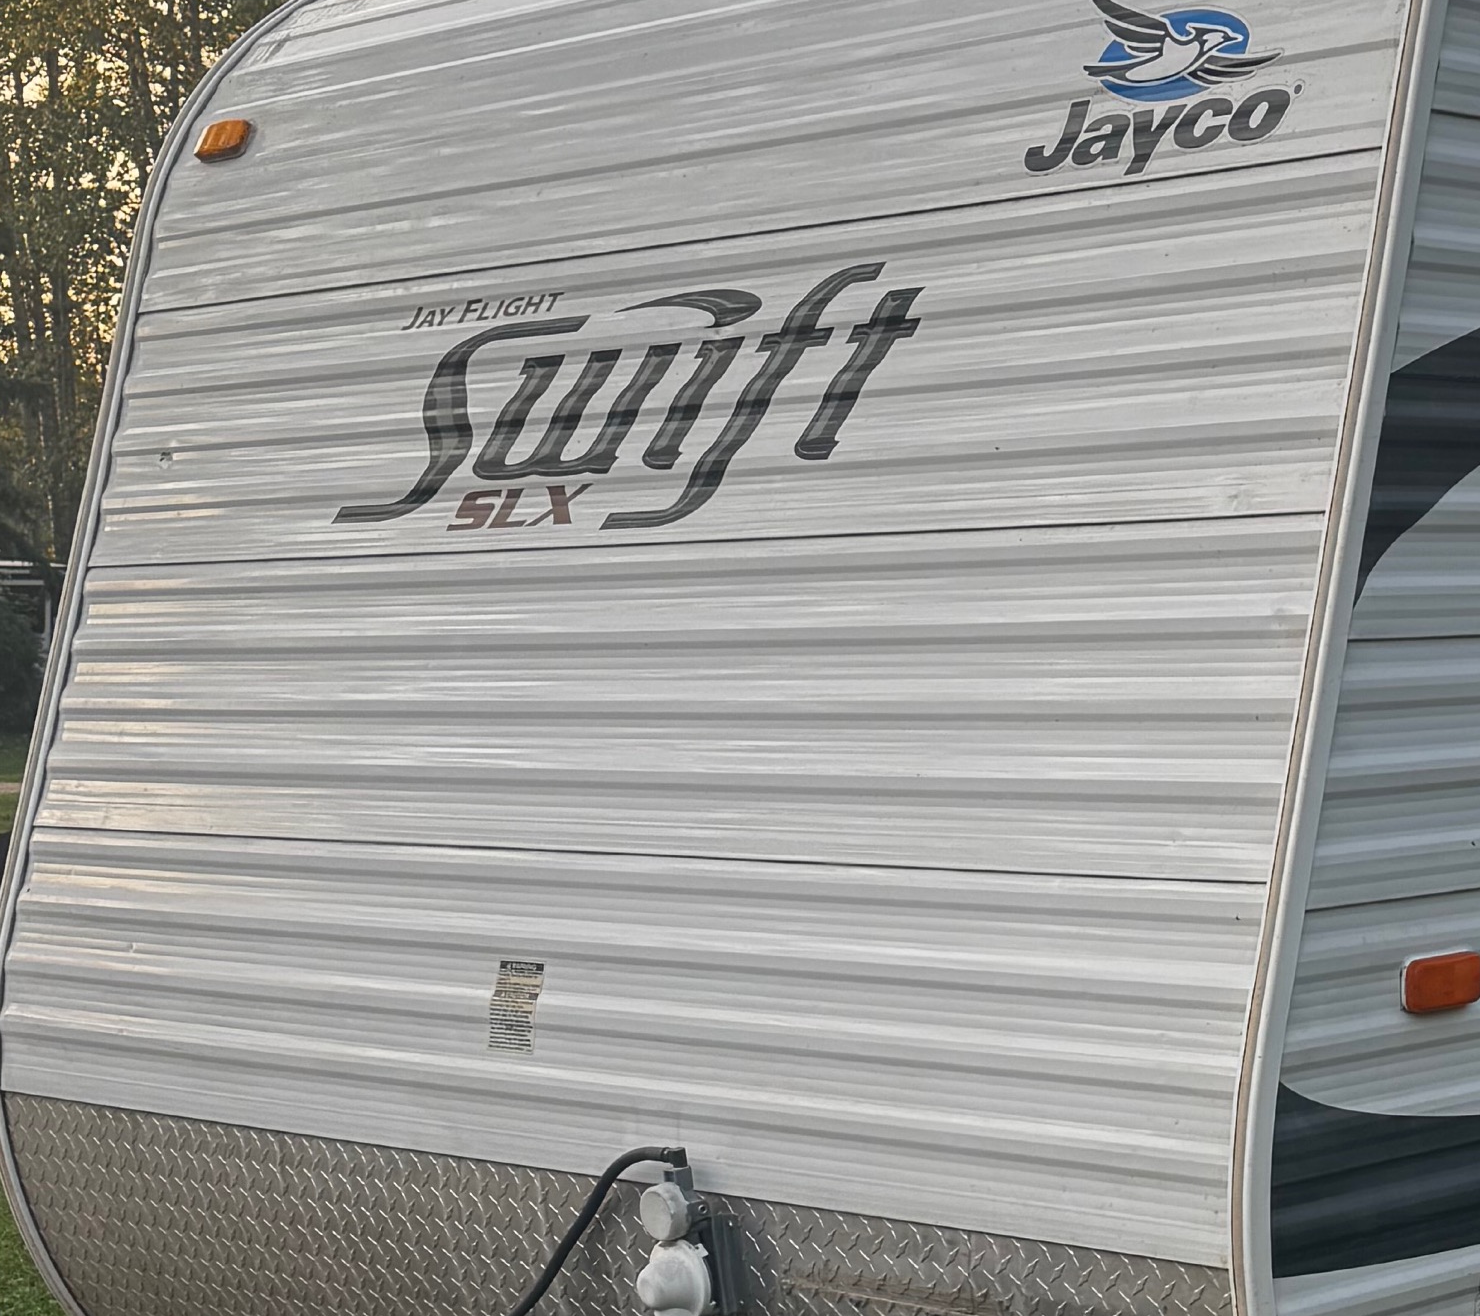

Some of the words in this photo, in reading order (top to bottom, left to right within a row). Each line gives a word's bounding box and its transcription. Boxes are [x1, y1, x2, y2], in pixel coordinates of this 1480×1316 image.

[1023, 88, 1291, 176] Jayco
[400, 306, 456, 331] JAY
[457, 291, 565, 324] FLIGHT
[331, 261, 925, 531] Swift
[446, 482, 594, 532] SLX
